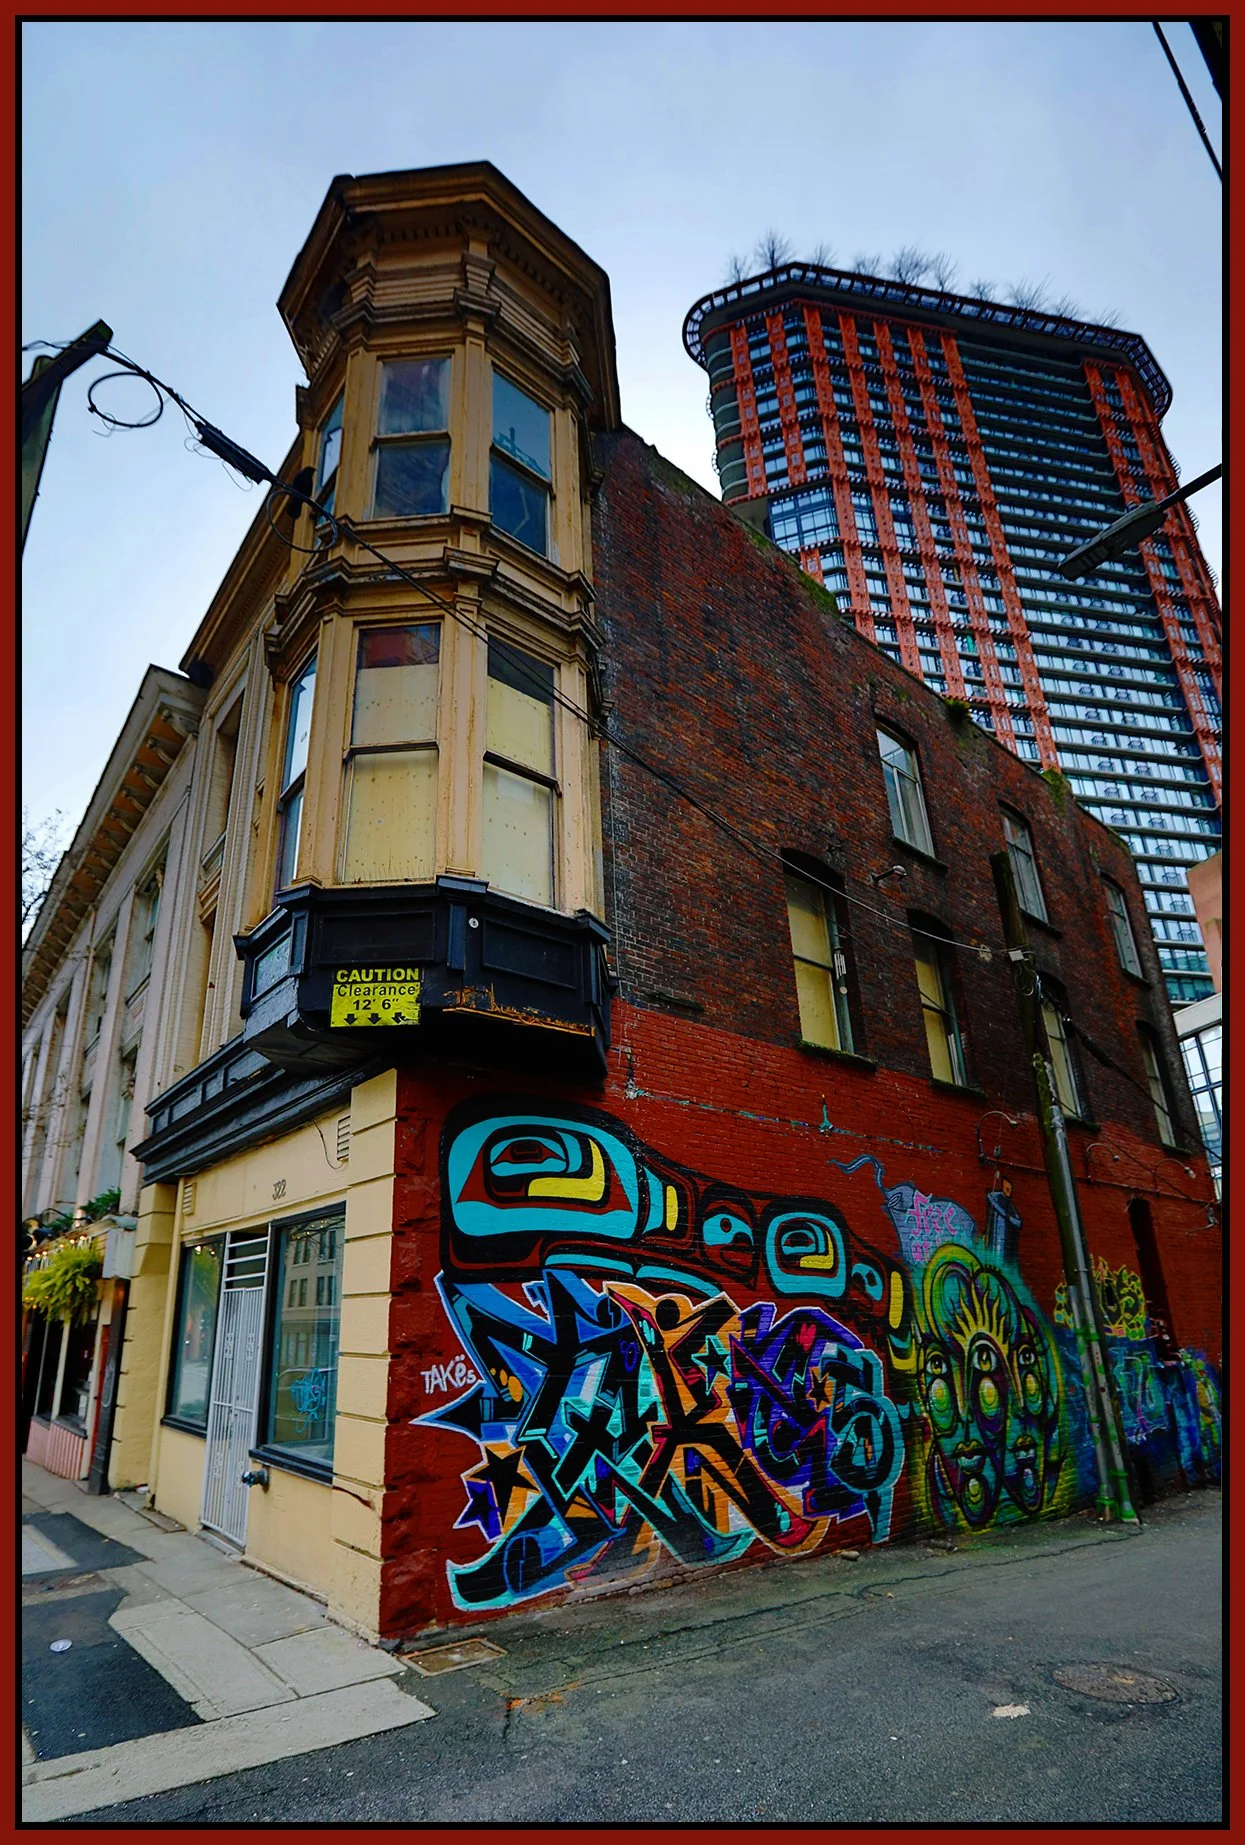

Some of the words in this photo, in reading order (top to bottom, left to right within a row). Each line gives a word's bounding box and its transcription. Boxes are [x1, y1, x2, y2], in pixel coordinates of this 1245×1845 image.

[336, 968, 419, 982] CAUTION
[337, 984, 416, 997] Clearance
[272, 1178, 287, 1201] 322
